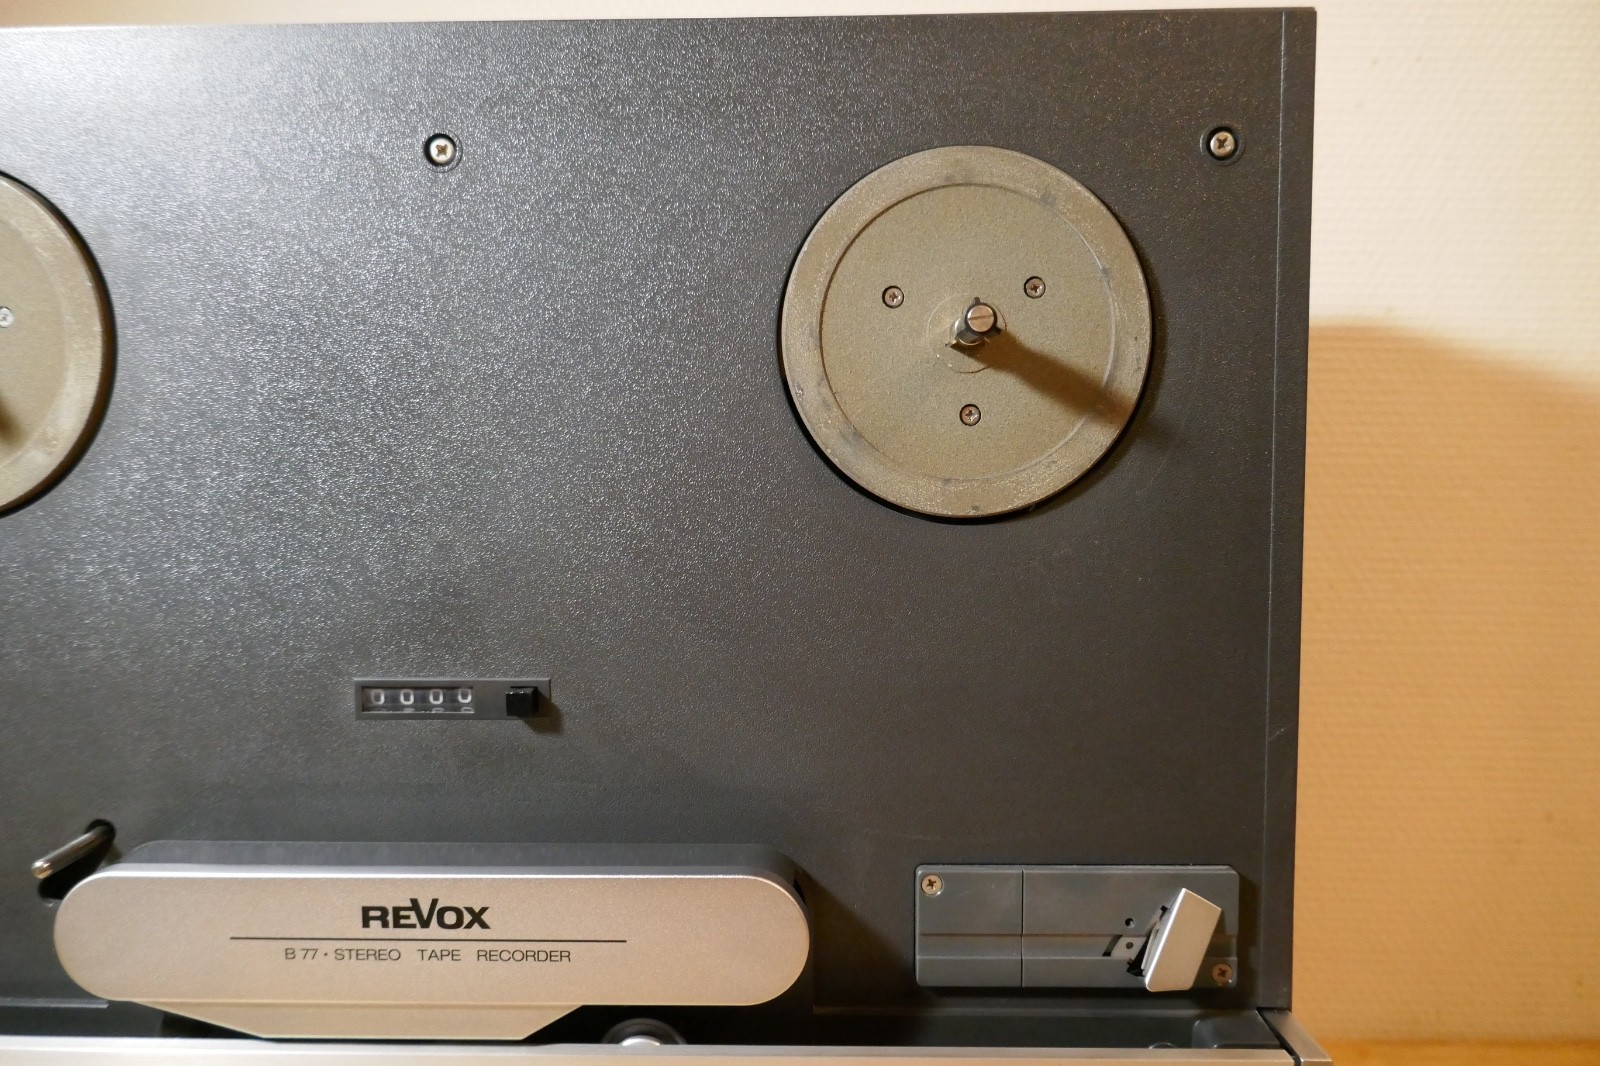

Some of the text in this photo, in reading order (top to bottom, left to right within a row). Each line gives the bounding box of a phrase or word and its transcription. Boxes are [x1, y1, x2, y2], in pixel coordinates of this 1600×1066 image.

[361, 898, 492, 930] REVOX
[284, 948, 572, 963] B 77 STEREO TAPE RECORDER
